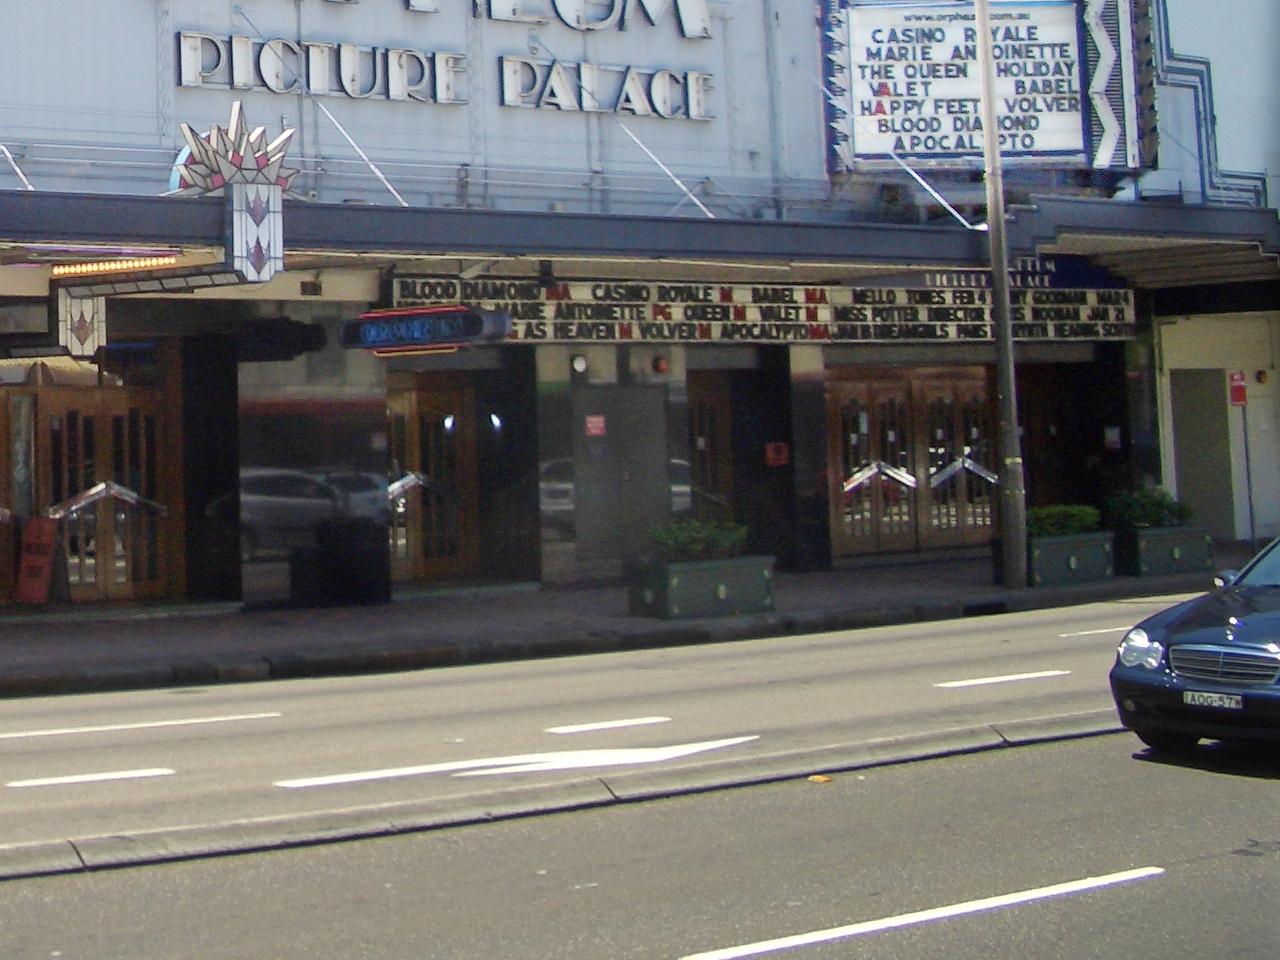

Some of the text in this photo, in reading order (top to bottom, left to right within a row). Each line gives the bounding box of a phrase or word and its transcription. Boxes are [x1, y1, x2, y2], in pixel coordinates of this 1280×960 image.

[871, 25, 1039, 44] CASINO RYALE
[866, 42, 1070, 61] MARIE ANOINETTE
[177, 31, 716, 121] PICTURE PALACE
[858, 62, 968, 80] THE QUEEN
[996, 60, 1076, 78] HOLIDAY
[869, 81, 932, 97] VALET
[1014, 78, 1079, 95] BABEL
[860, 98, 981, 116] HAPPY FEET
[1004, 96, 1080, 113] VOLVER
[877, 116, 942, 133] BLOOD
[893, 133, 1035, 151] APOCALPTO
[400, 280, 457, 300] BLOOD
[592, 283, 650, 302] CASINO
[658, 285, 713, 303] ROYALE
[553, 302, 646, 321] ANTOINETTE
[683, 304, 730, 322] QUEEN
[758, 306, 802, 322] VALET
[524, 322, 547, 339] AS
[553, 322, 616, 340] HEAVEN
[639, 322, 697, 340] VOLVER
[721, 322, 808, 340] APOCALYPTO
